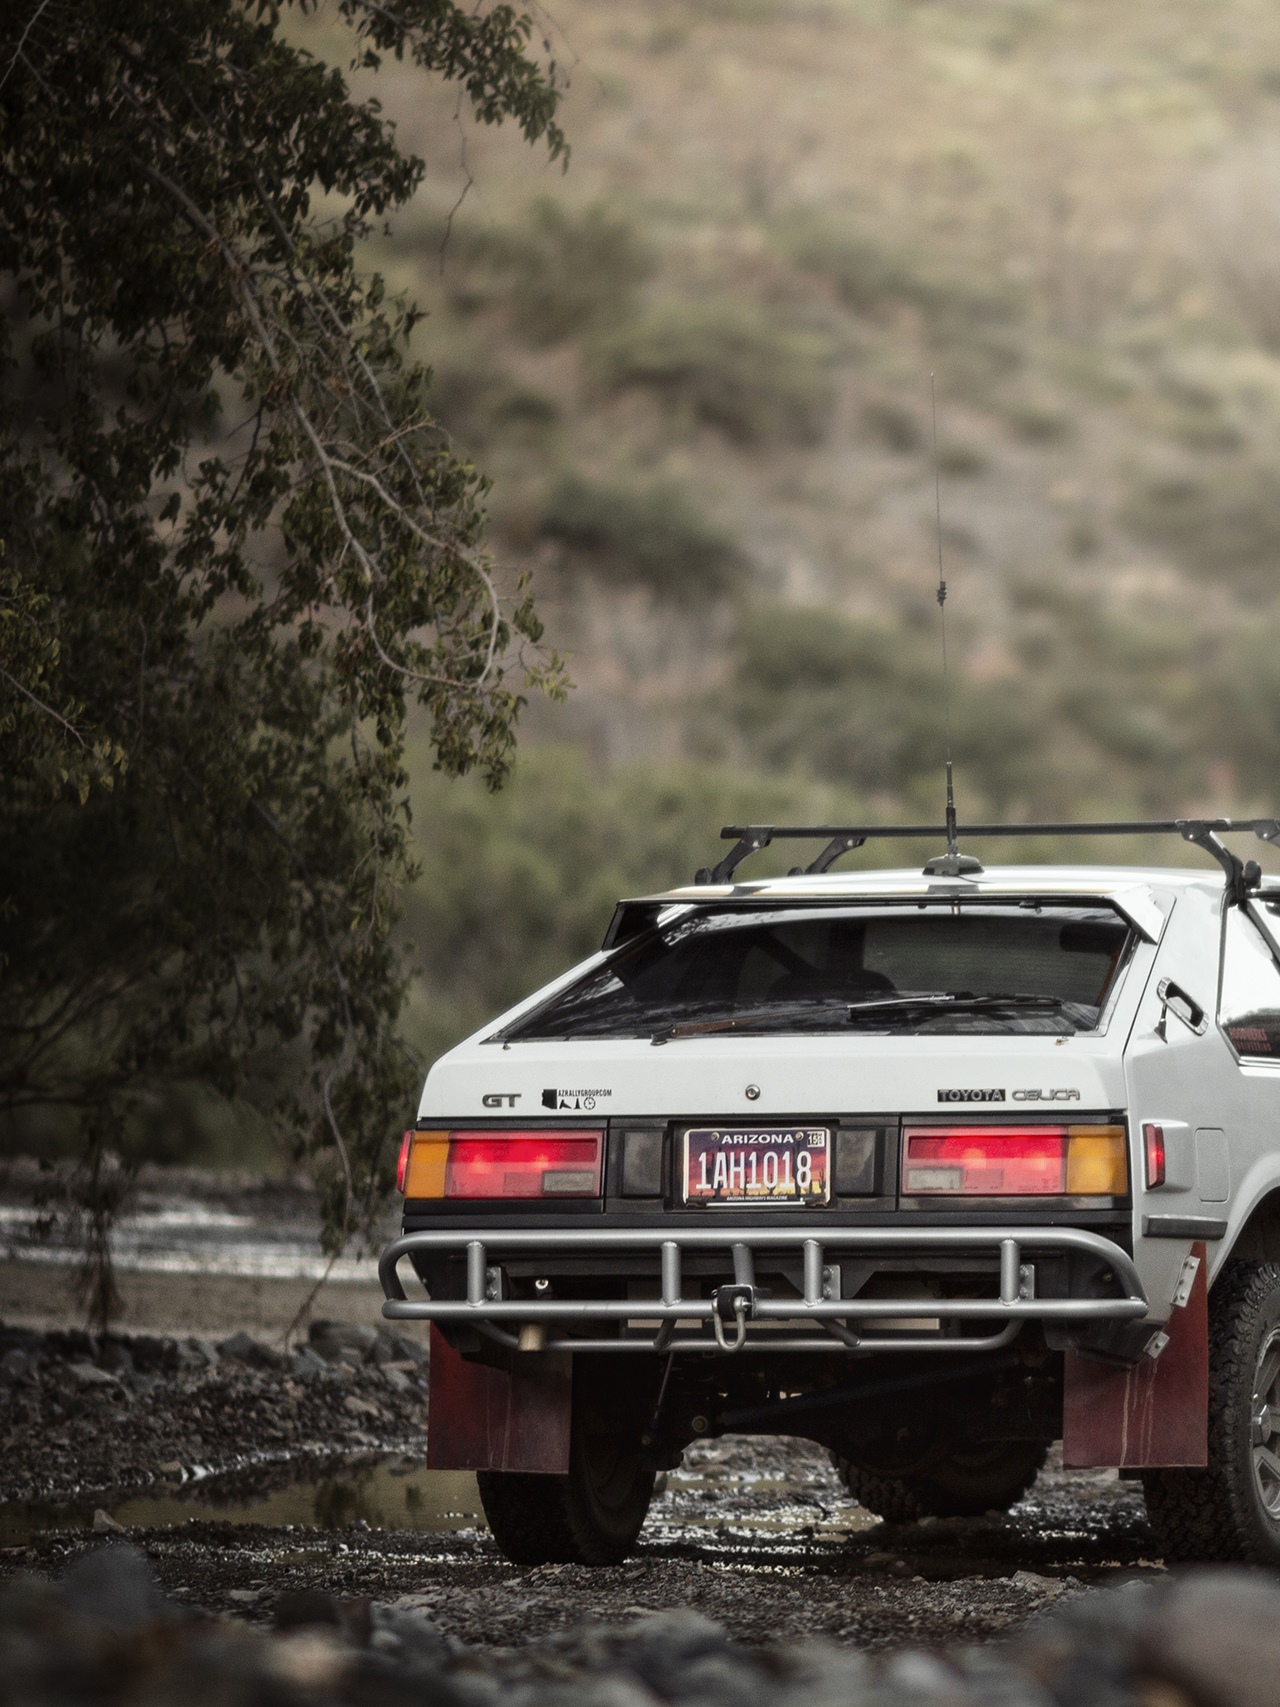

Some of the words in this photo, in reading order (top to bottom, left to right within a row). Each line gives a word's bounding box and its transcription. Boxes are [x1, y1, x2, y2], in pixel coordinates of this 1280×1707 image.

[558, 1089, 612, 1097] AZRALLYGROUP.COM
[938, 1089, 1004, 1102] TOYOTA
[1011, 1088, 1081, 1101] CELICA
[482, 1093, 522, 1108] GT
[721, 1133, 795, 1145] ARIZONA
[695, 1151, 812, 1190] 1AH1018
